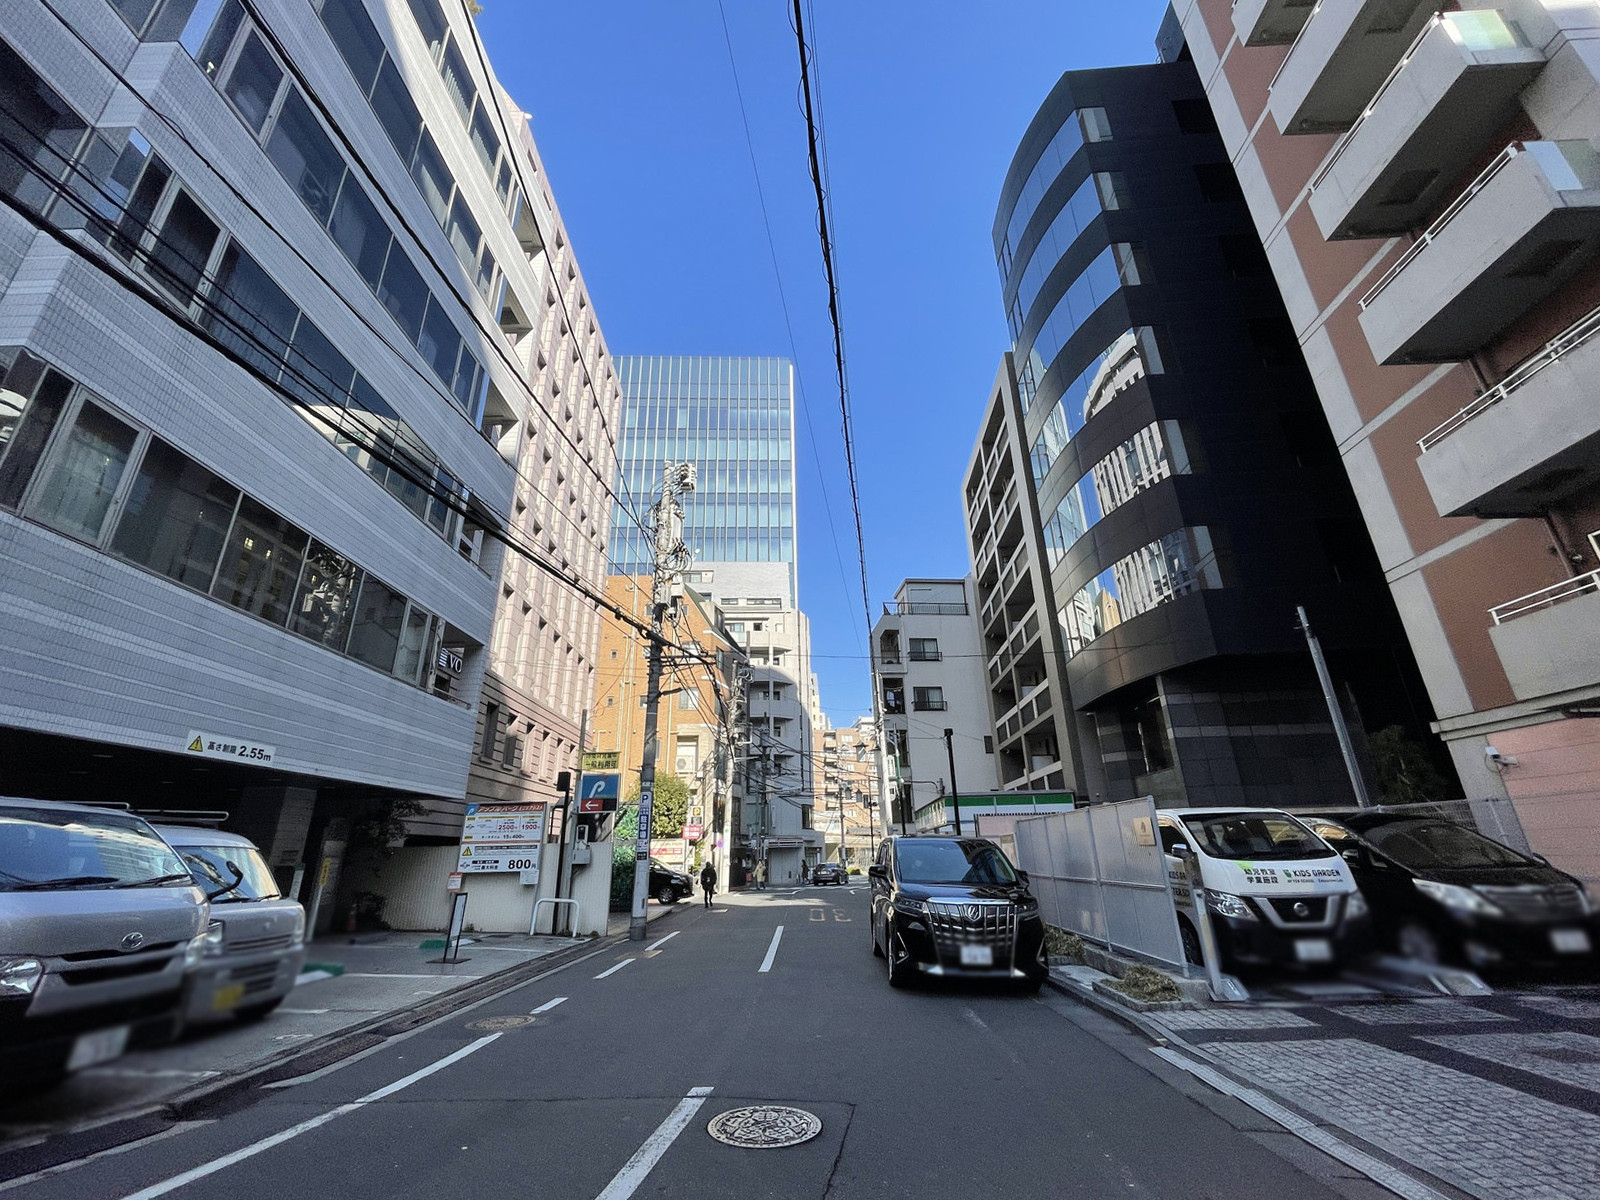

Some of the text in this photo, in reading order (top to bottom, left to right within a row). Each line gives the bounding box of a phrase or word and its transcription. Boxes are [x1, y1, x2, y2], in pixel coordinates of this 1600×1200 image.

[207, 741, 272, 761] 高さ制限 2.55m
[641, 794, 649, 804] P
[1244, 868, 1276, 876] 幼児教室
[1293, 869, 1341, 877] KIDS GARDEN
